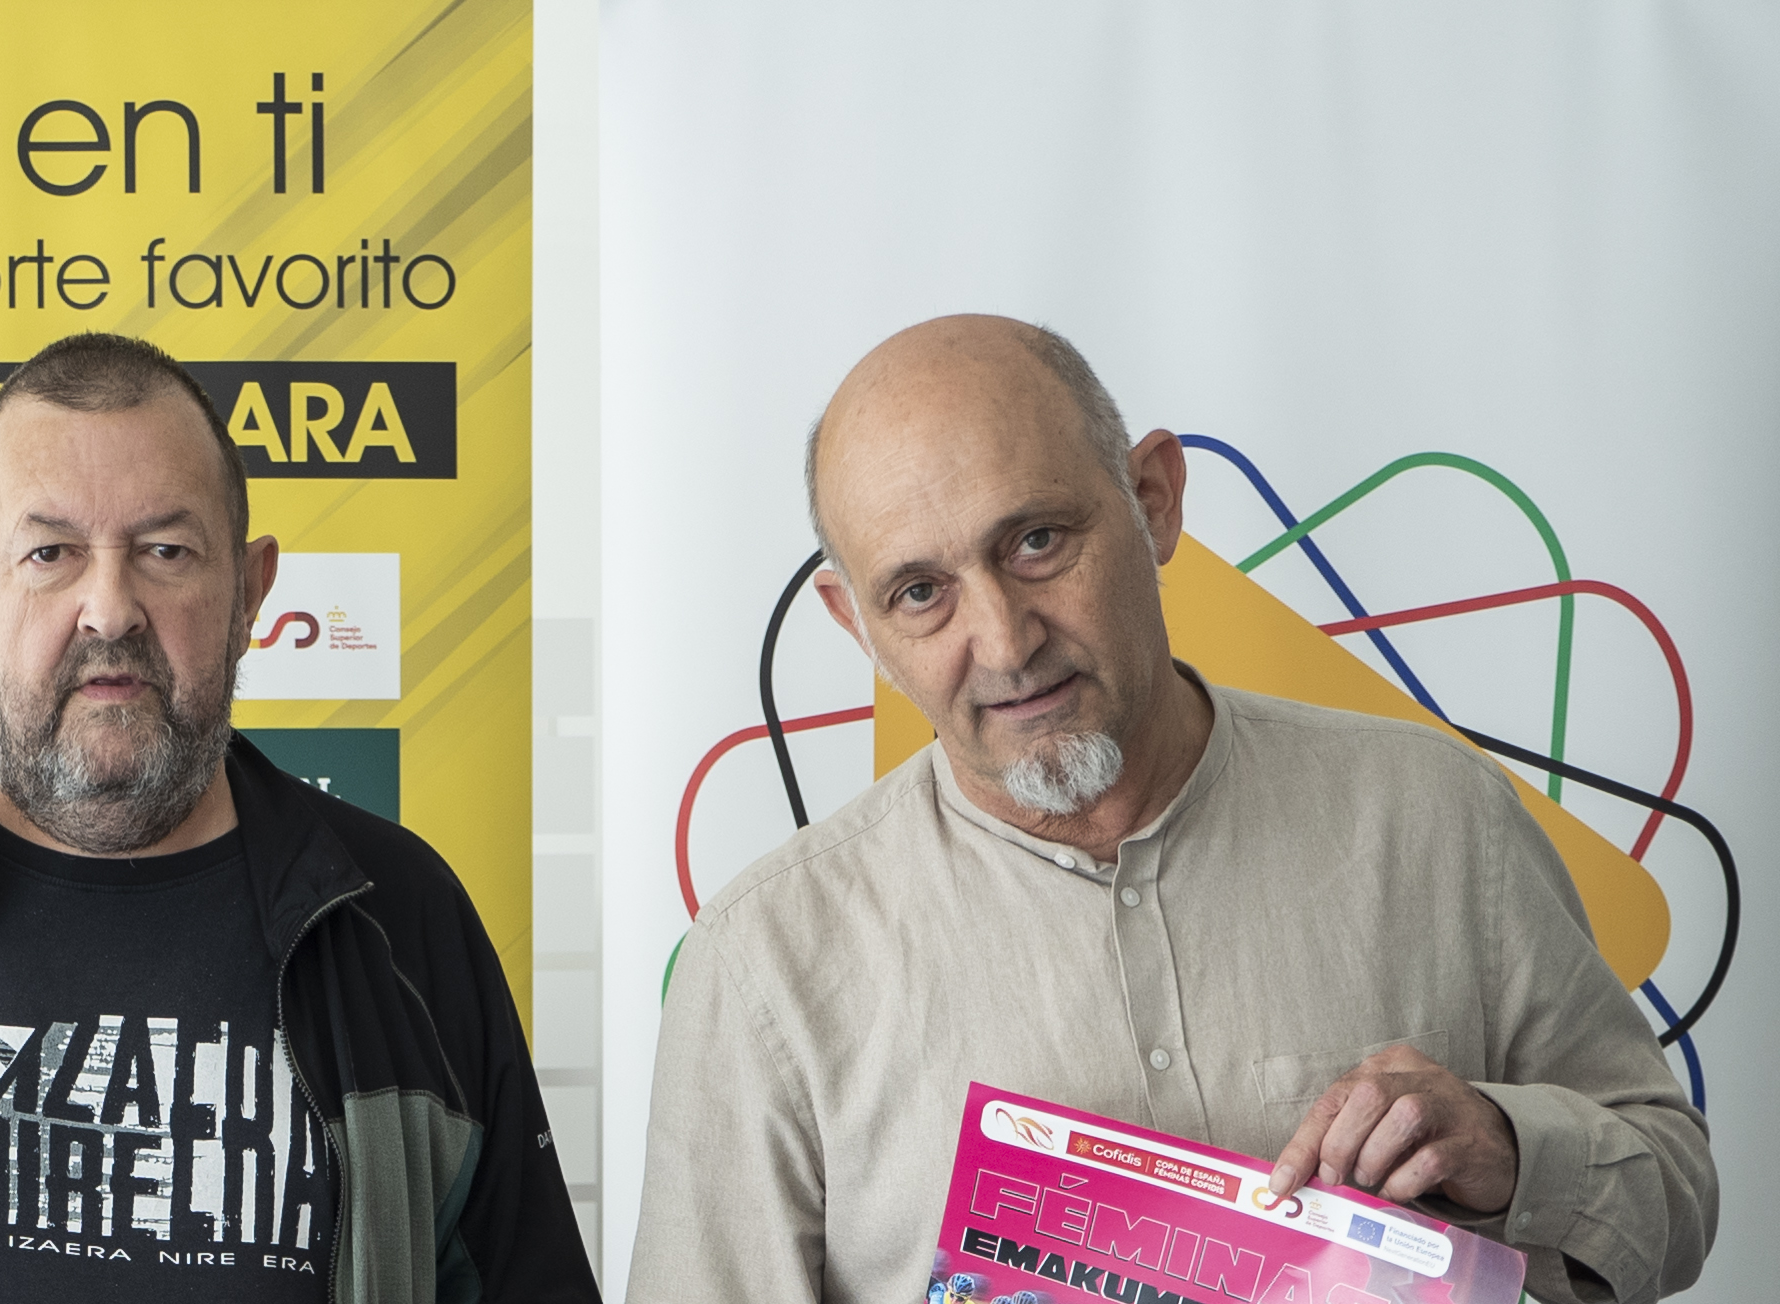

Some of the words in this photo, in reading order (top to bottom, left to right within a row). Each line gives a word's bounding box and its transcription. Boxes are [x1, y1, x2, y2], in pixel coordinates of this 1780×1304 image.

[18, 99, 202, 196] en
[256, 72, 326, 194] ti
[140, 237, 458, 311] favorito
[228, 382, 417, 463] ARA
[1092, 1144, 1141, 1166] Cofidis
[8, 1236, 132, 1263] IZAERA
[159, 1250, 236, 1266] NIRE
[263, 1254, 316, 1275] ERA
